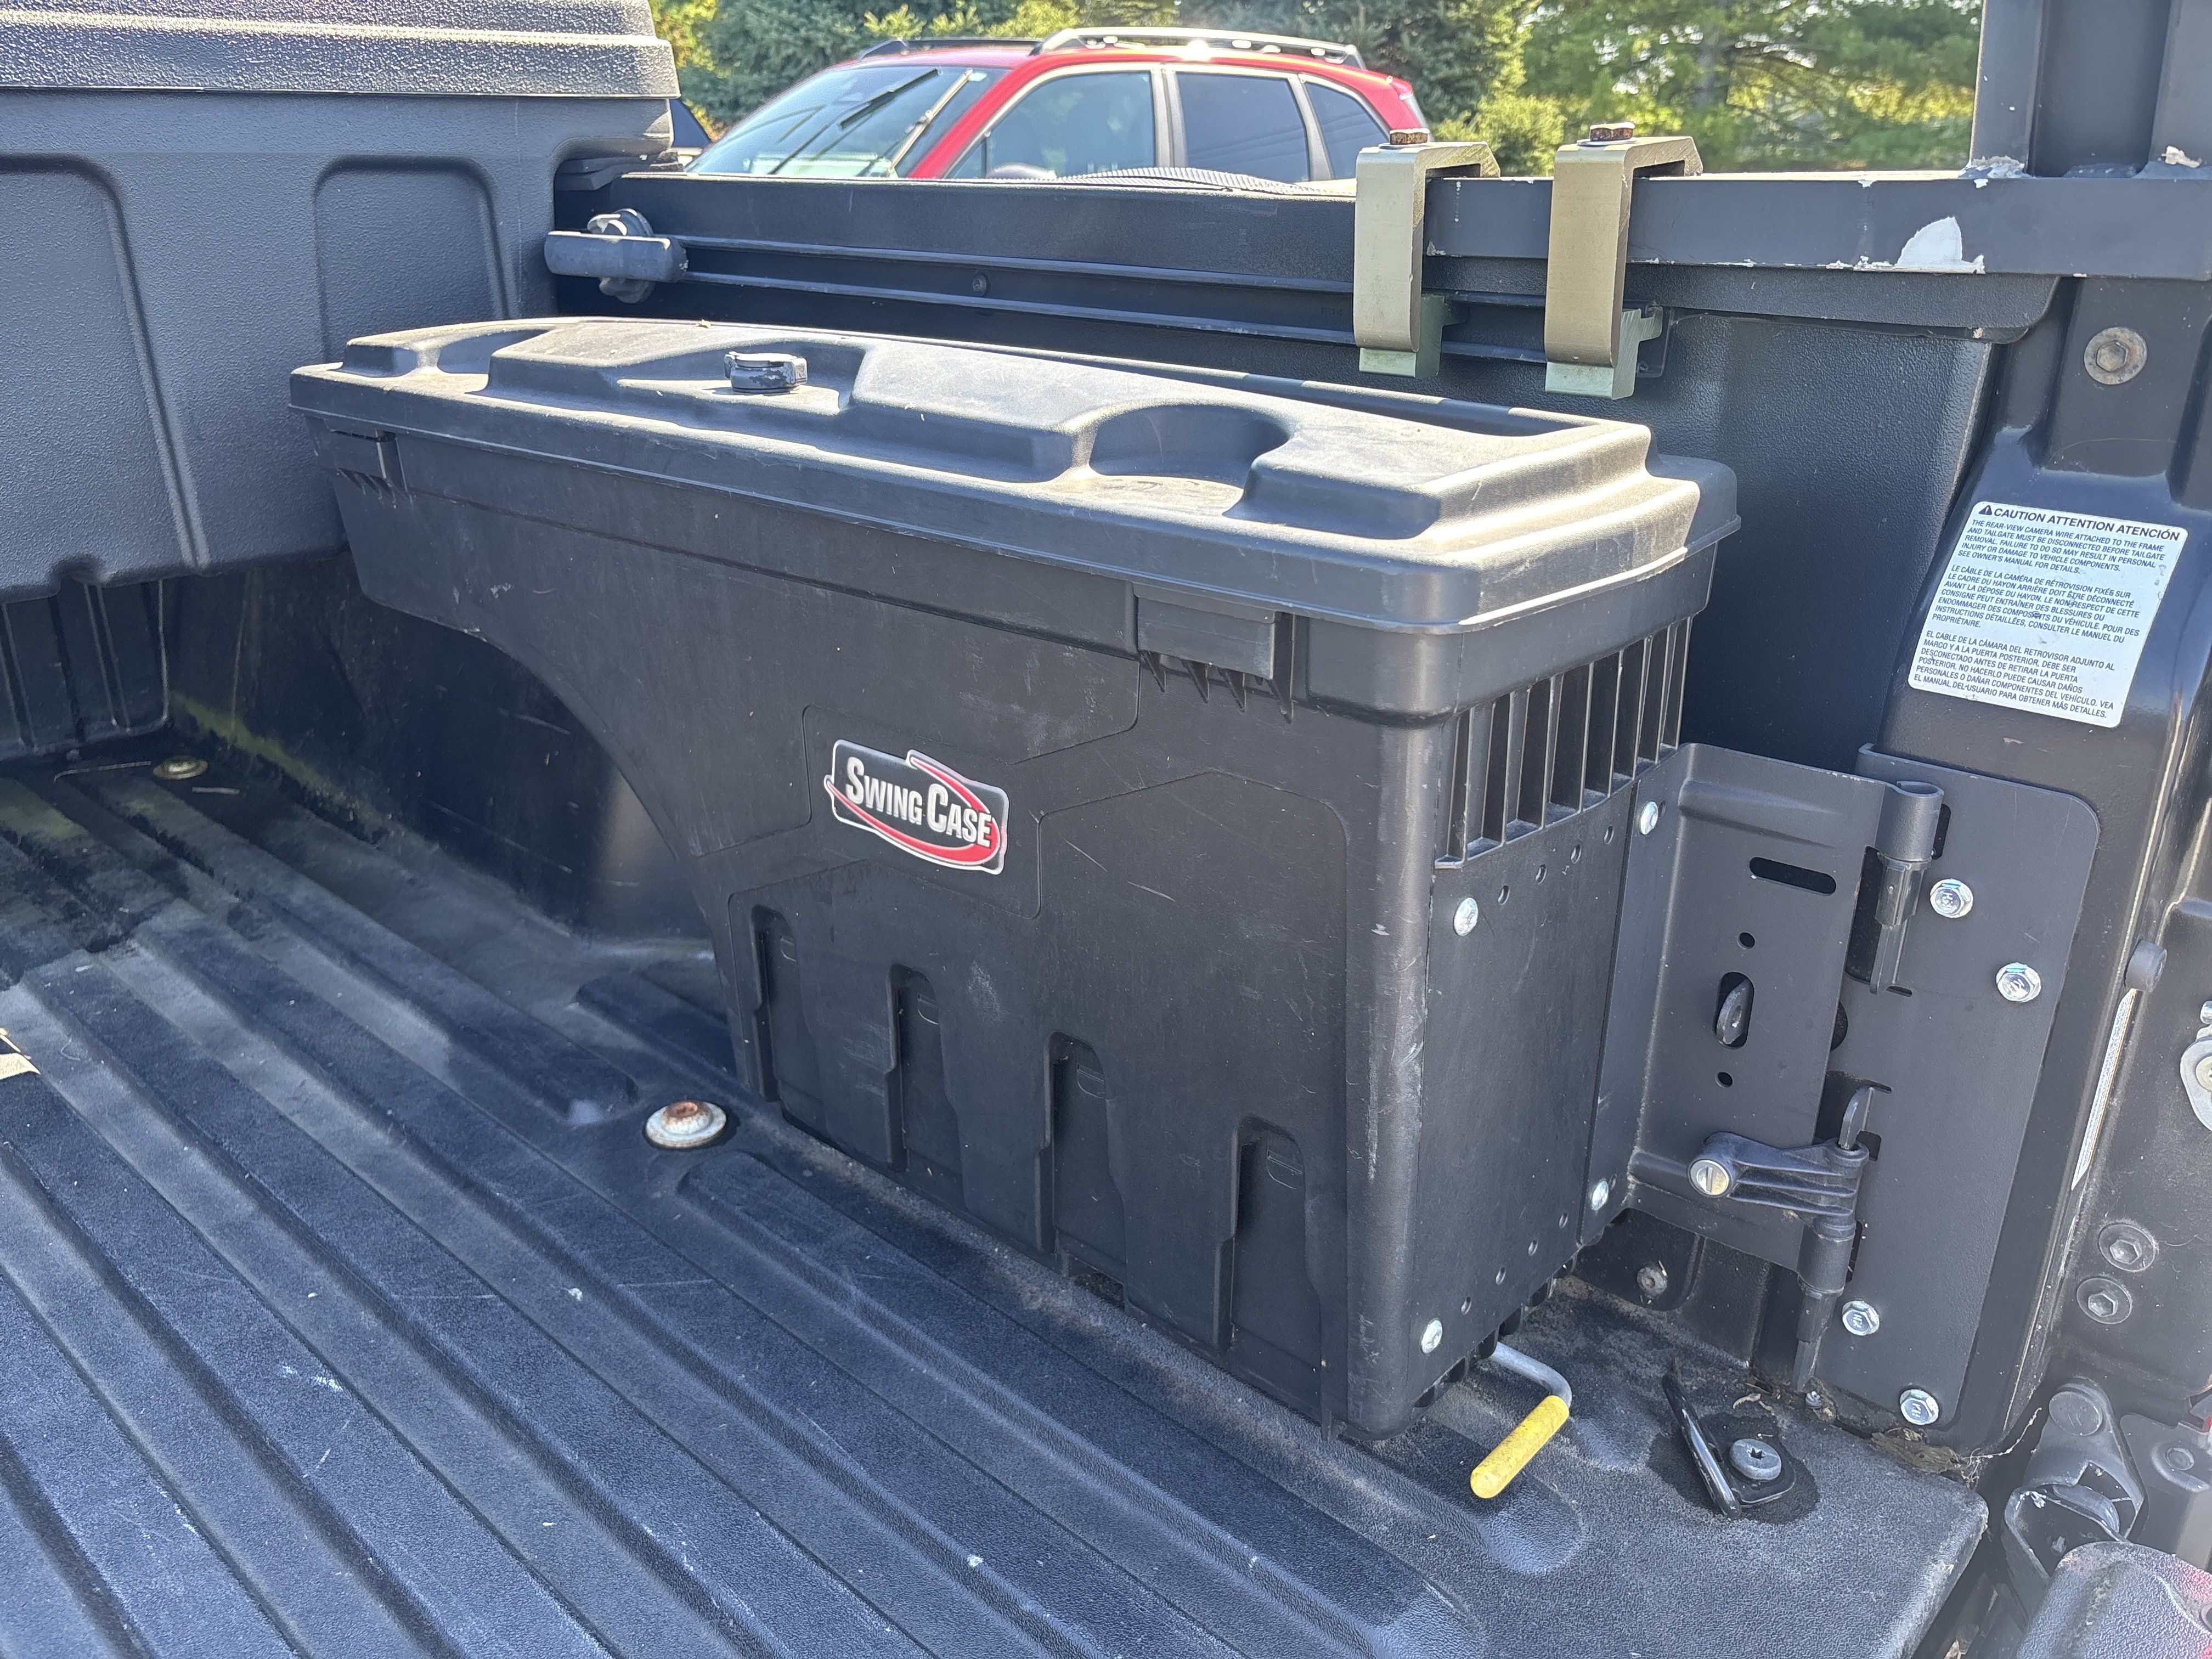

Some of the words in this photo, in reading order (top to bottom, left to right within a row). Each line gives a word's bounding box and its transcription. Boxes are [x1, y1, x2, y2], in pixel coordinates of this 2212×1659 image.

[1972, 519, 1985, 527] THE
[1985, 521, 2024, 532] REAR-VIEW
[2024, 526, 2053, 537] CAMERA
[2055, 530, 2074, 539] WIRE
[2074, 533, 2111, 544] ATTACHED
[2124, 540, 2138, 549] THE
[2138, 542, 2165, 552] FRAME
[1994, 508, 2046, 522] CAUTION
[2046, 515, 2115, 532] ATTENTION
[2115, 524, 2181, 541] ATENCIÓN
[1961, 542, 1987, 551] INJURY
[1997, 547, 2028, 557] DAMAGE
[2040, 553, 2069, 564] VEHICLE
[2069, 558, 2120, 572] COMPONENTS.
[1984, 529, 2016, 539] TAILGATE
[2015, 533, 2037, 542] MUST
[2047, 538, 2101, 551] DISCONNECTED
[2101, 545, 2131, 556] BEFORE
[2131, 550, 2165, 561] TAILGATE
[1999, 539, 2029, 549] FAILURE
[2062, 548, 2080, 556] MAY
[2079, 551, 2108, 561] RESULT
[2117, 556, 2156, 568] PERSONAL
[2004, 556, 2033, 567] MANUAL
[2034, 561, 2050, 569] FOR
[2050, 563, 2080, 574] DETAILS.
[1944, 580, 1967, 590] AVANT
[1977, 585, 2005, 596] DÉPOSE
[2005, 590, 2017, 598] DU
[2016, 591, 2042, 602] HAYON.
[2044, 596, 2054, 604] LE
[2105, 606, 2117, 614] DE
[2117, 608, 2140, 618] CETTE
[1957, 574, 1981, 584] CADRE
[1992, 579, 2017, 589] HAYON
[2048, 588, 2067, 597] DOIT
[2086, 594, 2135, 608] DÉCONNECTÉ
[2004, 573, 2033, 584] CAMÉRA
[2045, 579, 2094, 593] RÉTROVISION
[2114, 590, 2131, 599] SUR
[1938, 596, 1987, 611] ENDOMMAGER
[1987, 605, 2002, 613] DES
[2051, 615, 2063, 623] DU
[2102, 624, 2124, 634] POUR
[2124, 628, 2140, 637] DES
[1941, 588, 1976, 600] CONSIGNE
[1976, 594, 1995, 603] PEUT
[2035, 603, 2050, 612] DES
[2050, 606, 2093, 619] BLESSURES
[2094, 613, 2106, 622] OU
[1934, 605, 1984, 619] INSTRUCTIONS
[2028, 620, 2070, 634] CONSULTER
[2070, 628, 2081, 636] LE
[2081, 629, 2112, 641] MANUEL
[2113, 635, 2125, 644] DU
[1921, 647, 1973, 663] DESCONECTADO
[1973, 657, 1996, 668] ANTES
[1997, 662, 2008, 670] DE
[2008, 663, 2039, 676] RETIRAR
[2050, 672, 2078, 684] PUERTA
[1923, 639, 1948, 650] MARCO
[1971, 647, 1997, 659] PUERTA
[2041, 660, 2061, 670] DEBE
[2061, 664, 2076, 674] SER
[1936, 631, 1957, 642] CABLE
[1957, 636, 1968, 644] DE
[1978, 639, 2007, 651] CÁMARA
[2008, 645, 2022, 654] DEL
[2023, 647, 2069, 663] RETROVISOR
[2069, 656, 2104, 669] ADJUNTO
[2104, 662, 2115, 671] AL
[1916, 665, 1959, 680] PERSONALES
[1966, 674, 1990, 686] DAÑAR
[1991, 679, 2044, 696] COMPONENTES
[2044, 690, 2058, 699] DEL
[2100, 700, 2113, 710] VEA
[1958, 664, 1970, 672] NO
[1970, 666, 2002, 679] HACERLO
[2002, 672, 2027, 683] PUEDE
[2027, 676, 2056, 689] CAUSAR
[2057, 682, 2083, 694] DAÑOS
[1922, 675, 1951, 687] MANUAL
[1952, 681, 1966, 690] DEL
[1966, 684, 1997, 696] USUARIO
[1998, 690, 2017, 701] PARA
[2018, 694, 2051, 707] OBTENER
[2051, 701, 2069, 710] MÁS
[2069, 704, 2107, 718] DETALLES.
